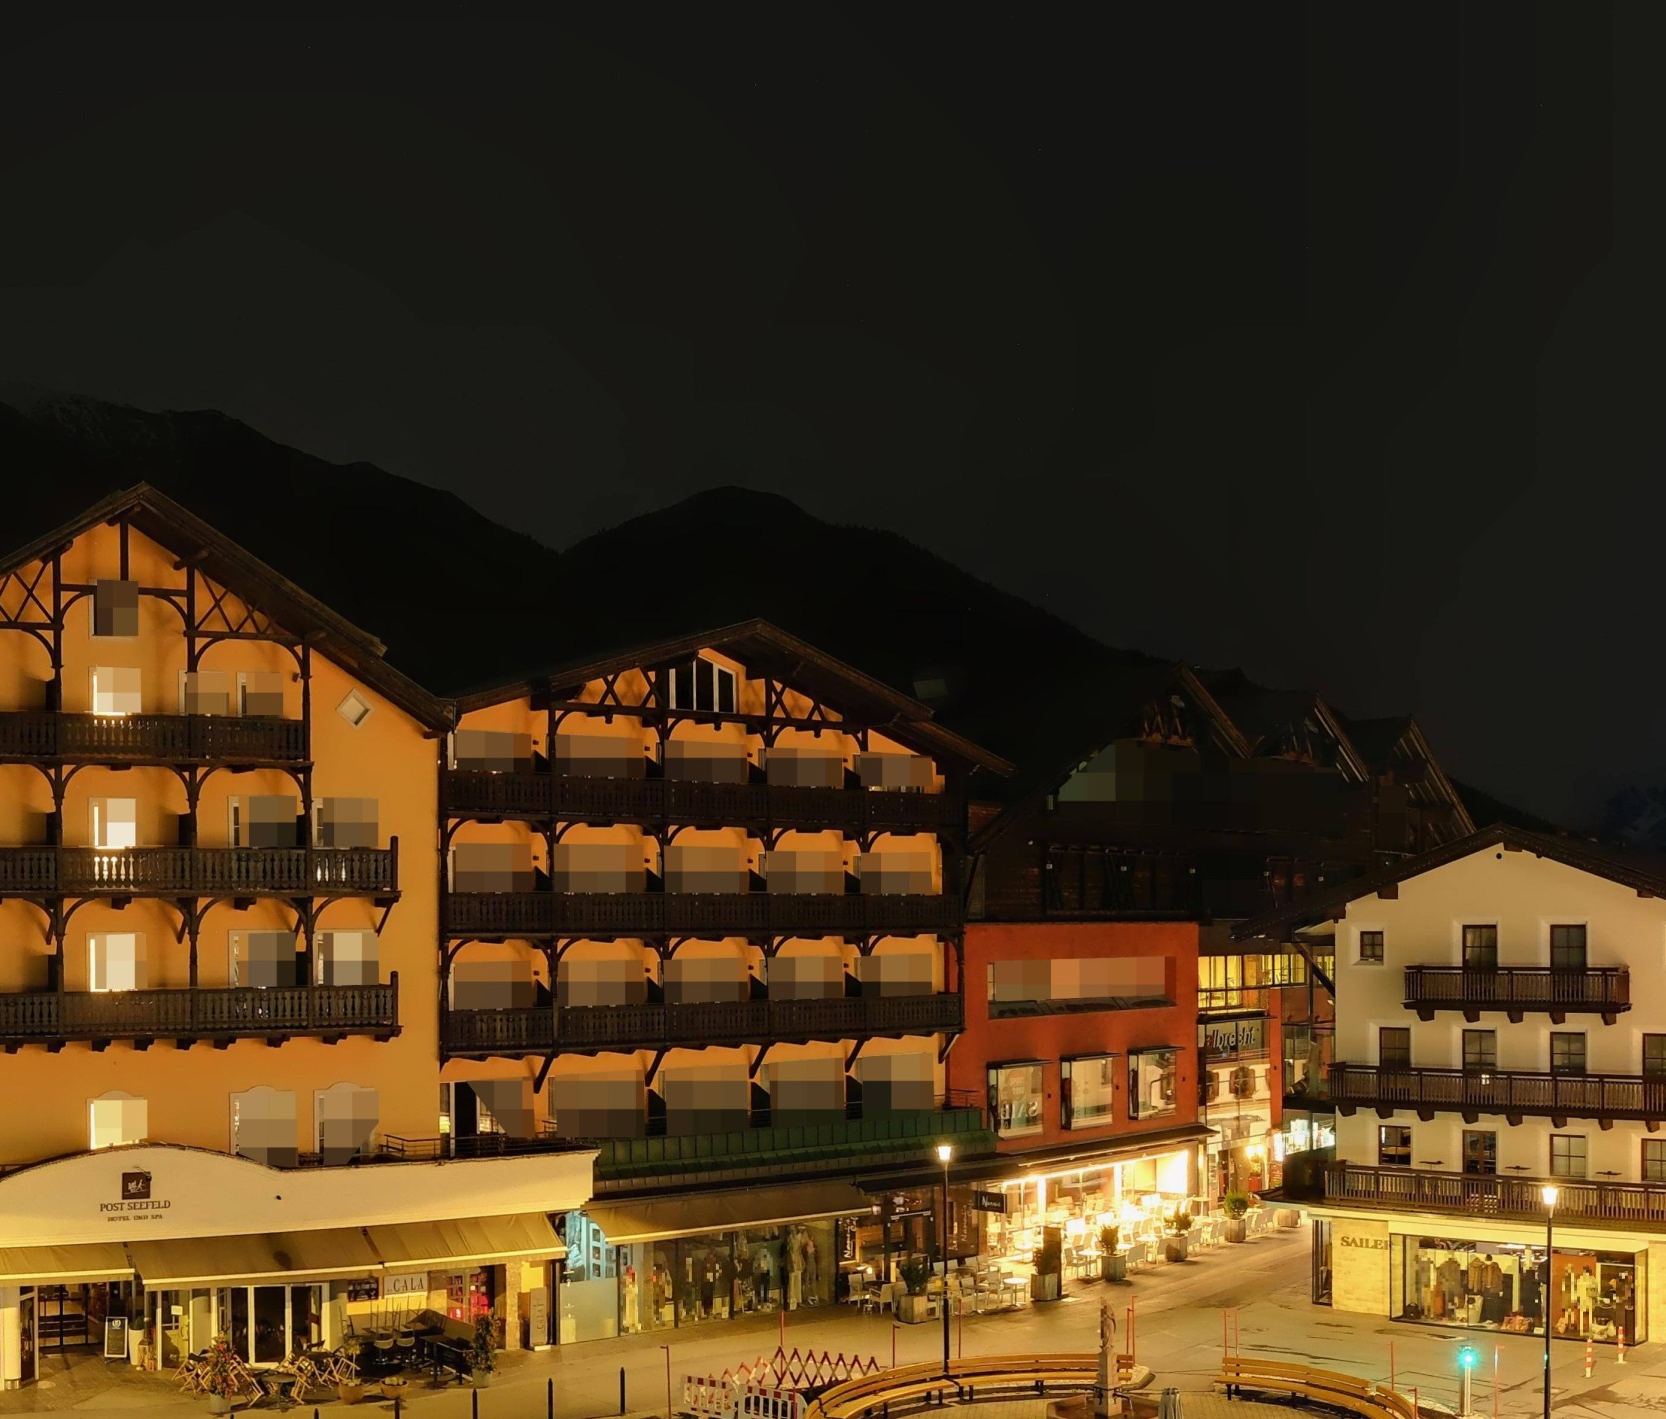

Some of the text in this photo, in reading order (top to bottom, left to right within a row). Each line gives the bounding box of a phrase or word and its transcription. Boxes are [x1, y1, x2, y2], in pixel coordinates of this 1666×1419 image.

[100, 1200, 171, 1212] POST SEEFELD
[393, 1278, 424, 1292] CALA
